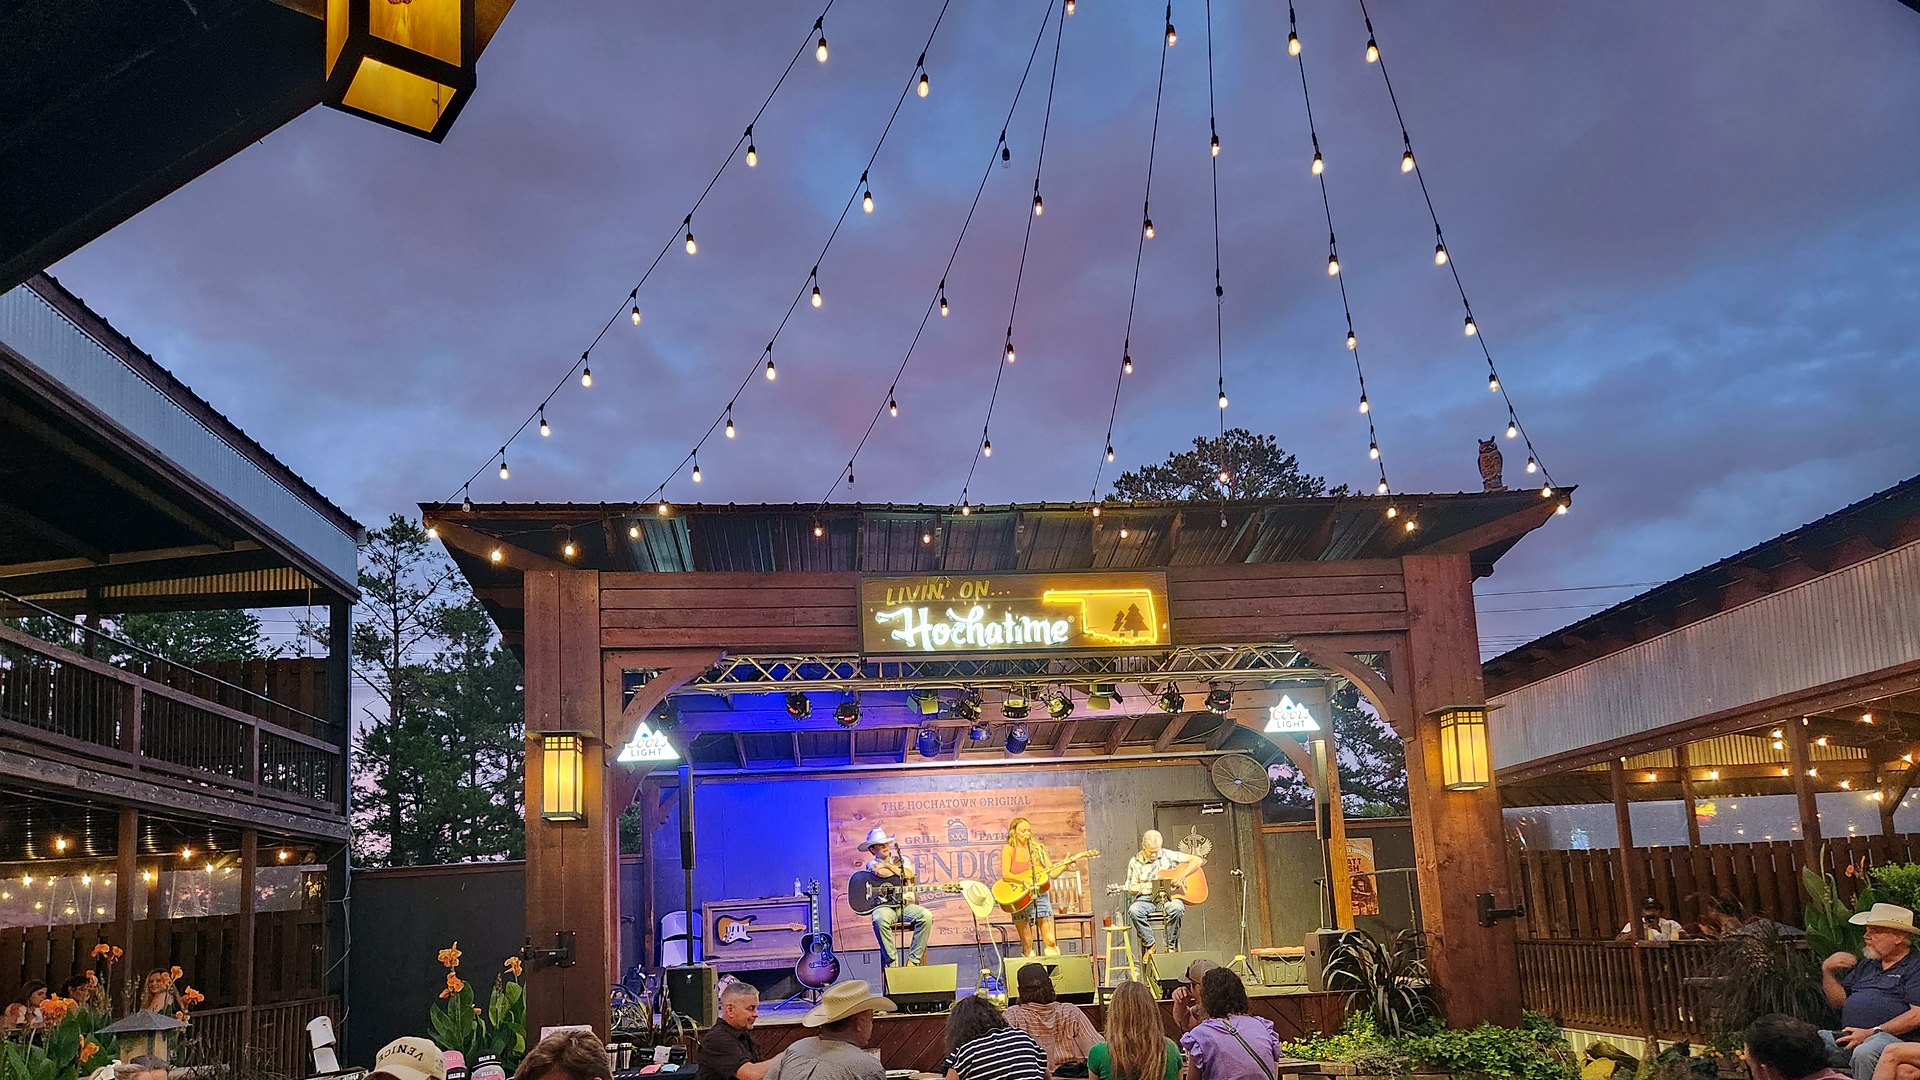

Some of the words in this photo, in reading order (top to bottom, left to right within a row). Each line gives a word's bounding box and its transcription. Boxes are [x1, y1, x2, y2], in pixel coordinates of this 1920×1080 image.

[885, 579, 950, 606] LIVIN'
[875, 606, 1069, 650] Hochatime
[1277, 720, 1305, 728] LIGHT
[630, 748, 662, 757] LIGHT
[881, 801, 905, 812] THE
[907, 798, 976, 810] HOCHATOWN
[979, 795, 1031, 807] ORIGINAL
[904, 835, 939, 845] GRILL
[939, 927, 960, 935] EST
[378, 1044, 424, 1063] VENICE
